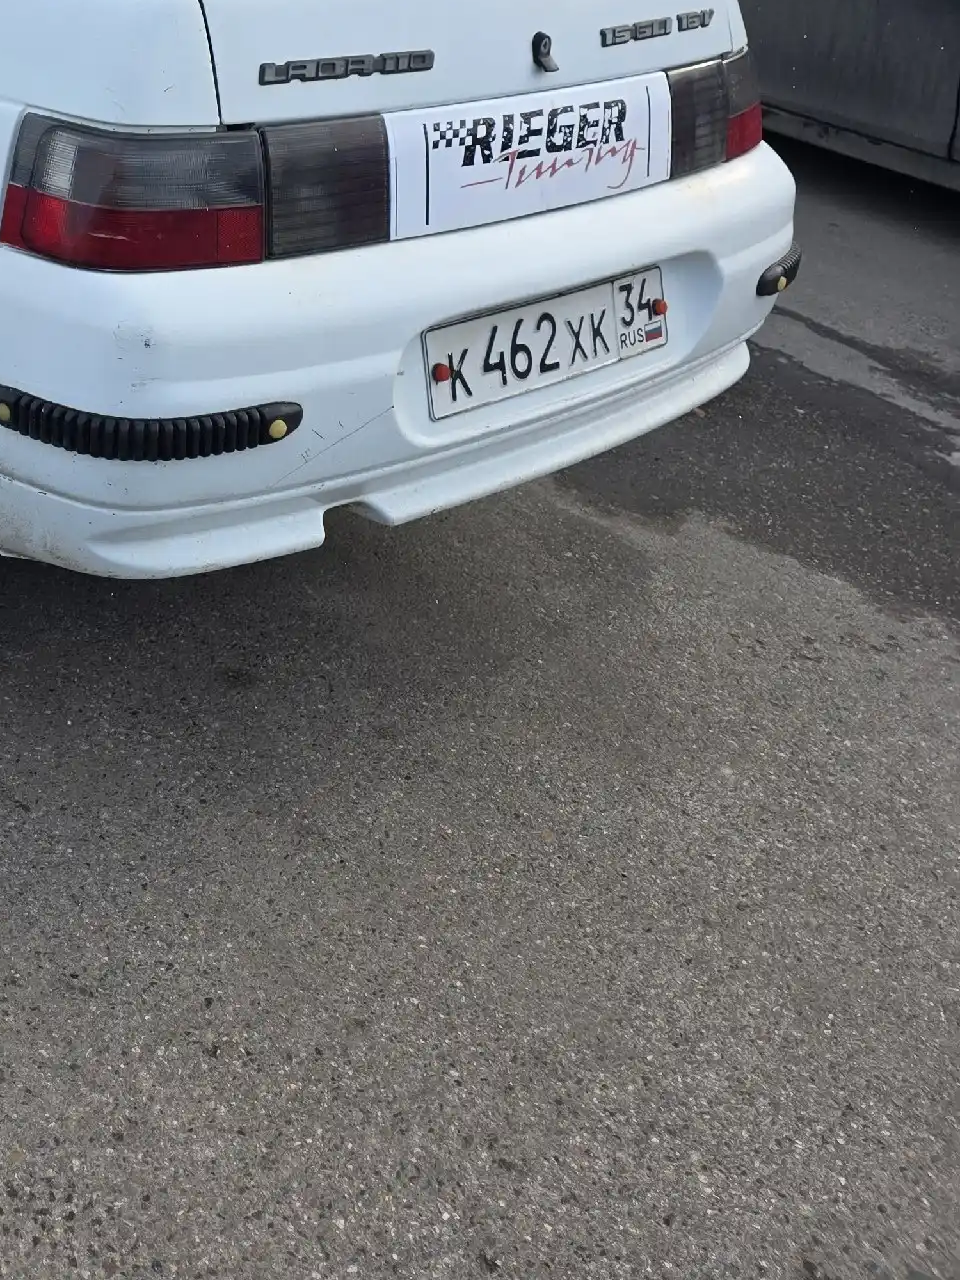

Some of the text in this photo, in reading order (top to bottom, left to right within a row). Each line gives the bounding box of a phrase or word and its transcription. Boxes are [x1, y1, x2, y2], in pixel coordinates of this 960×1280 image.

[632, 17, 673, 41] GLI
[676, 8, 715, 32] 16V
[259, 49, 435, 86] LADA 110
[461, 99, 627, 167] RIEGER
[619, 277, 654, 327] 34
[620, 327, 645, 350] RUS
